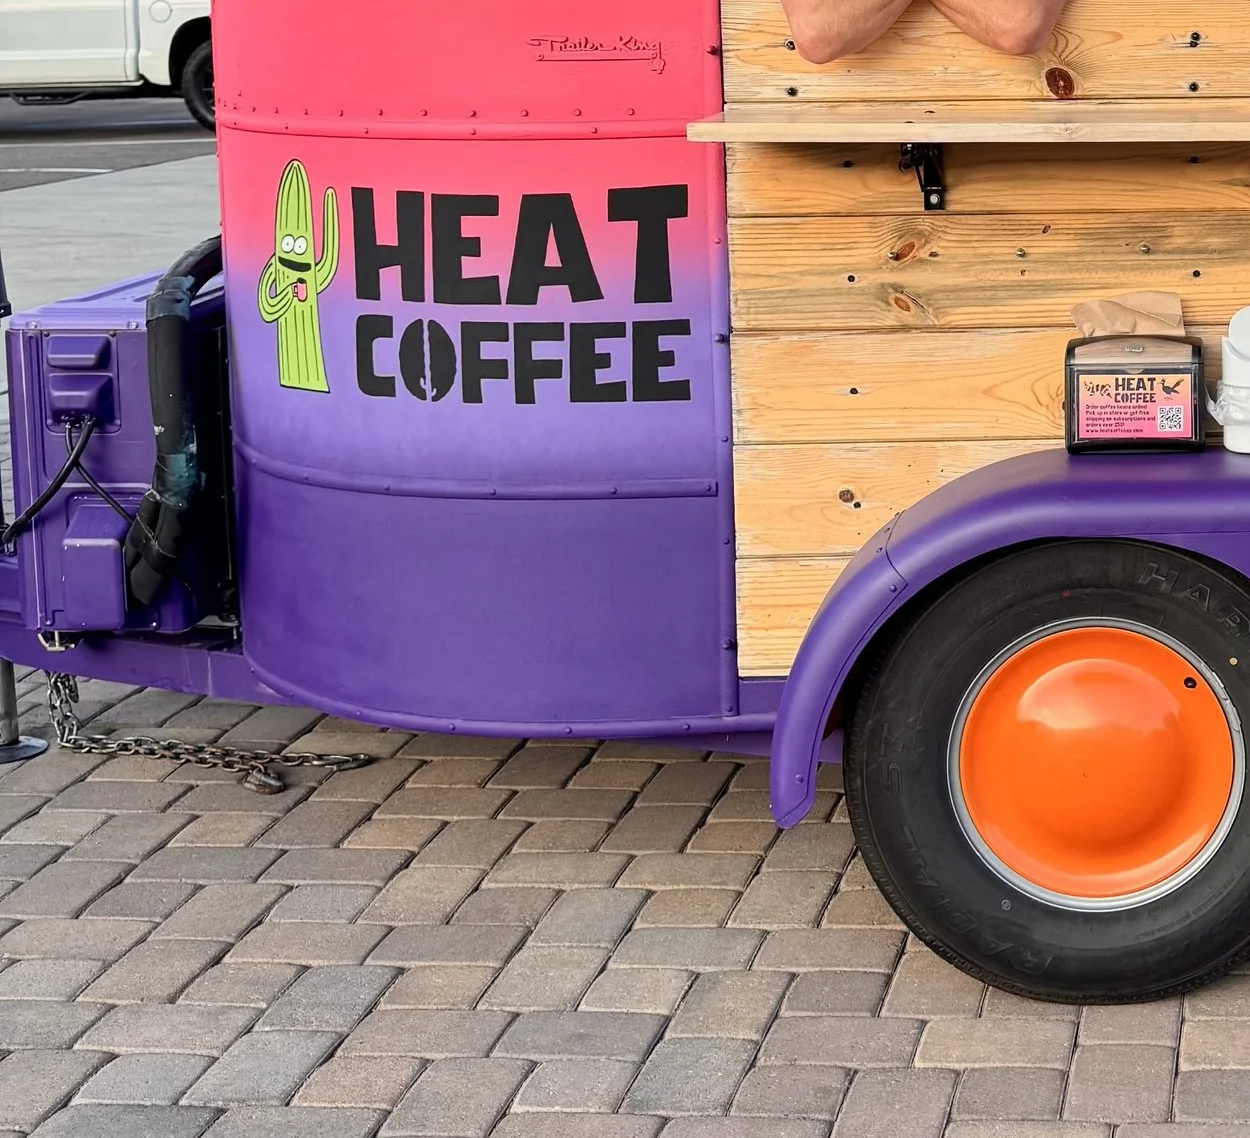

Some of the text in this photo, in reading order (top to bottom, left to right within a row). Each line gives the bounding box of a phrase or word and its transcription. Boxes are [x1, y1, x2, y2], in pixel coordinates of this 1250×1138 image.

[351, 184, 688, 306] HEAT
[356, 314, 691, 404] COFFEE
[1115, 378, 1156, 391] HEAT
[1114, 393, 1156, 403] COFFEE
